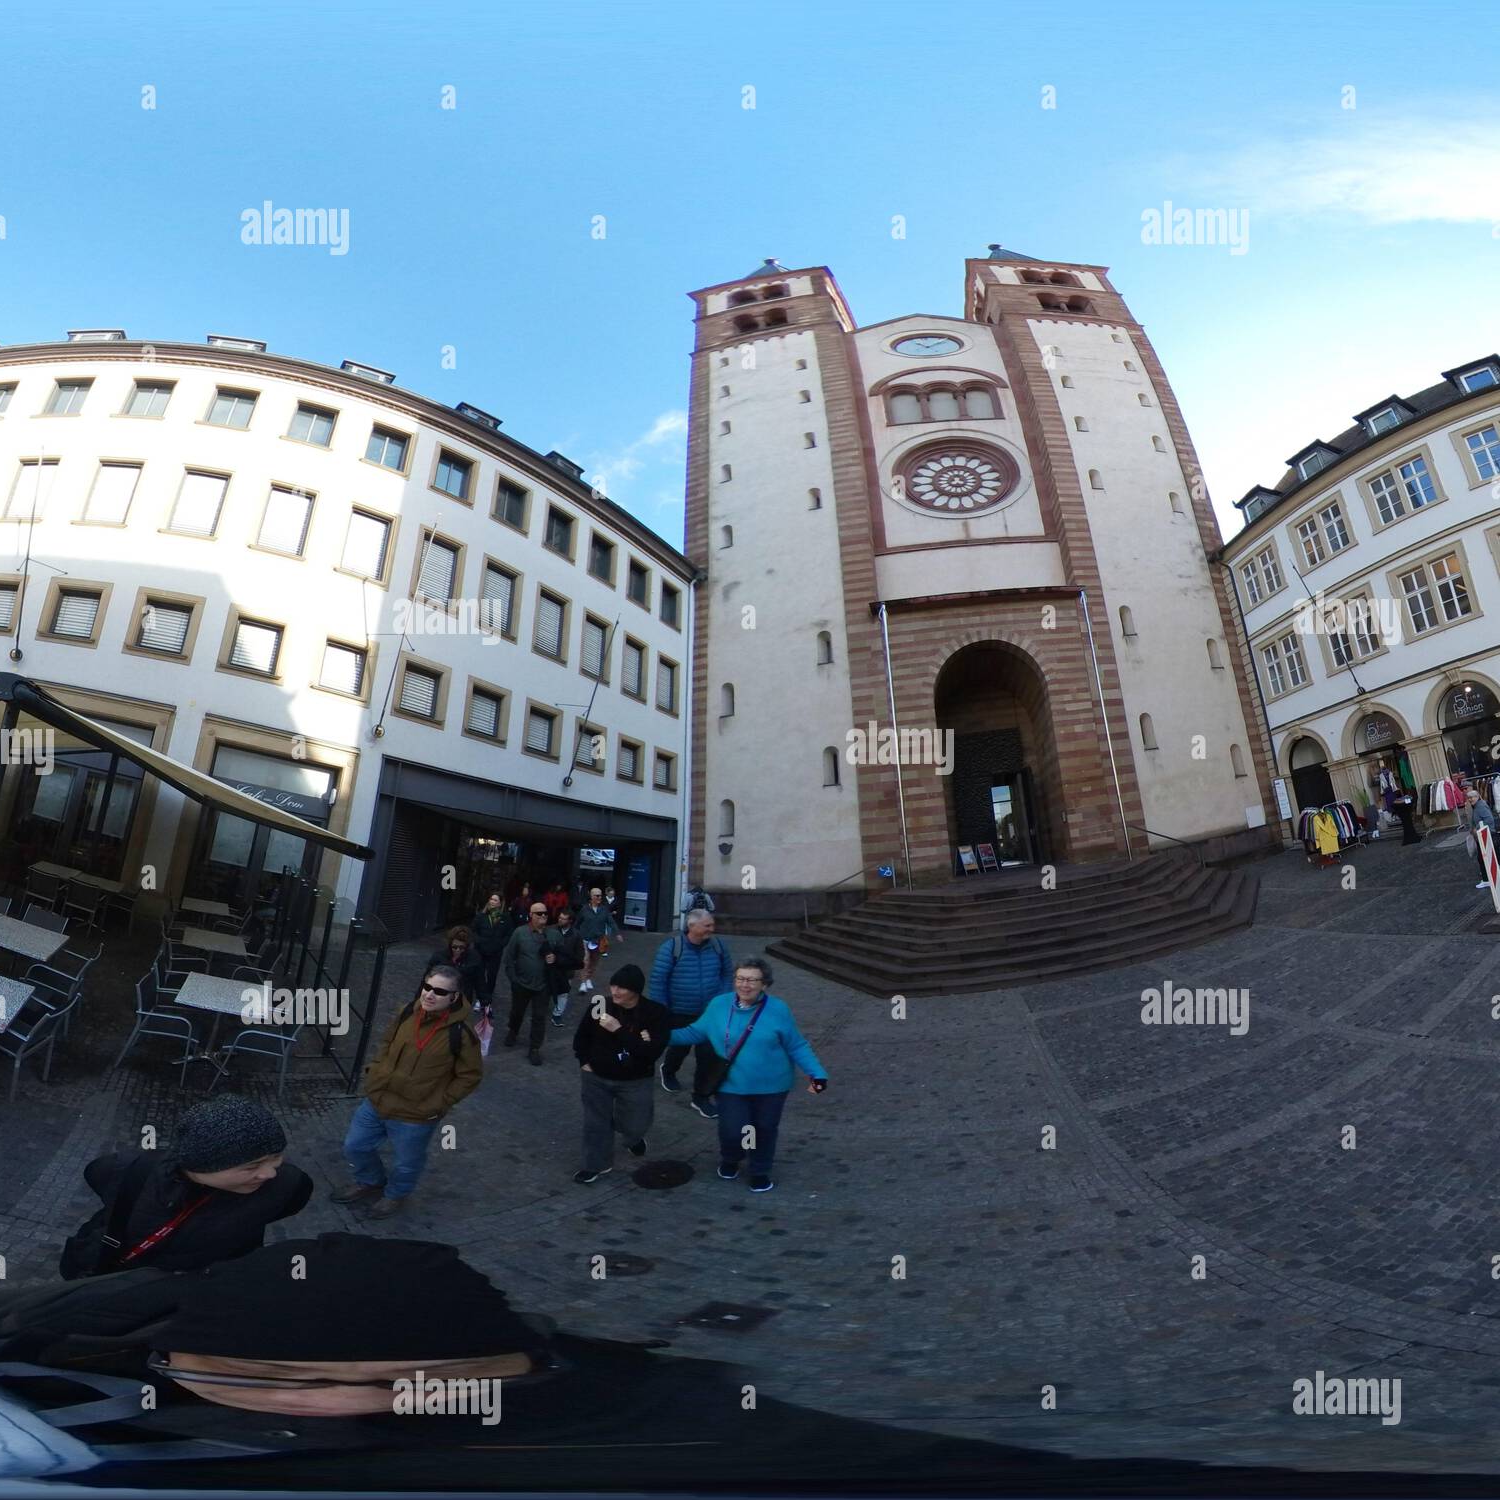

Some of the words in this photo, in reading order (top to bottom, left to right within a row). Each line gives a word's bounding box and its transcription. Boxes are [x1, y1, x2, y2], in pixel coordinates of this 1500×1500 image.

[1454, 693, 1465, 709] 5
[1453, 702, 1484, 719] fashion
[1367, 731, 1392, 745] fashion
